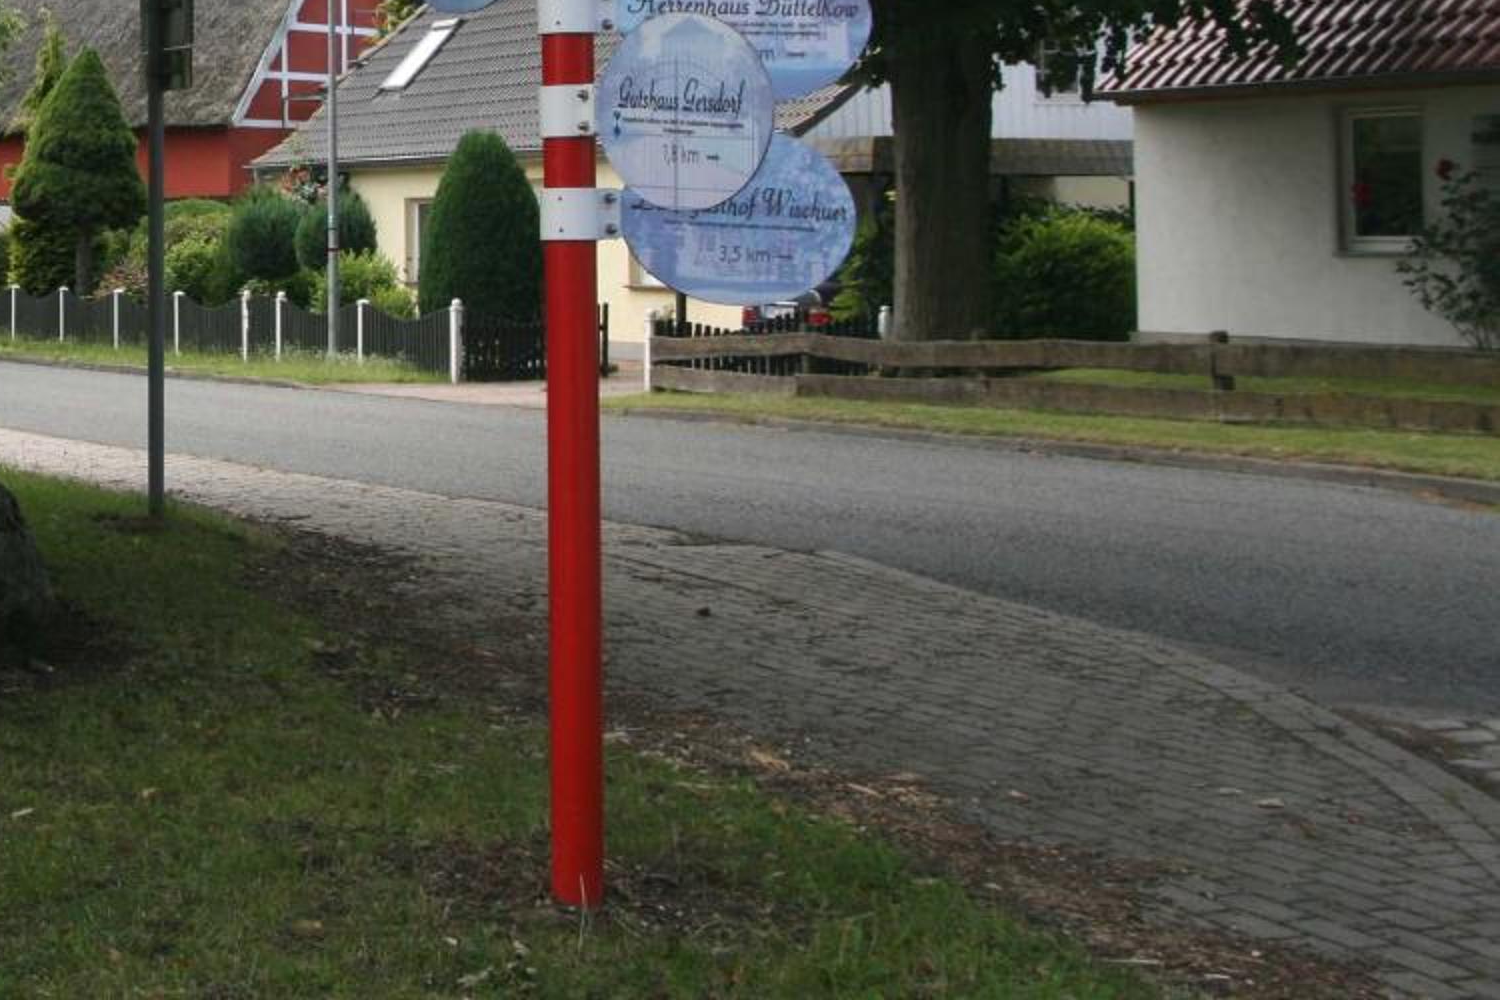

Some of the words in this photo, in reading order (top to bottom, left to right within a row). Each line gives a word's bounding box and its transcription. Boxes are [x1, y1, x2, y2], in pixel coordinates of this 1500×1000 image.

[617, 75, 679, 111] Gutshaus
[681, 77, 746, 119] Gersdorf
[681, 146, 700, 165] km
[718, 244, 741, 264] 3,5
[746, 246, 772, 263] km
